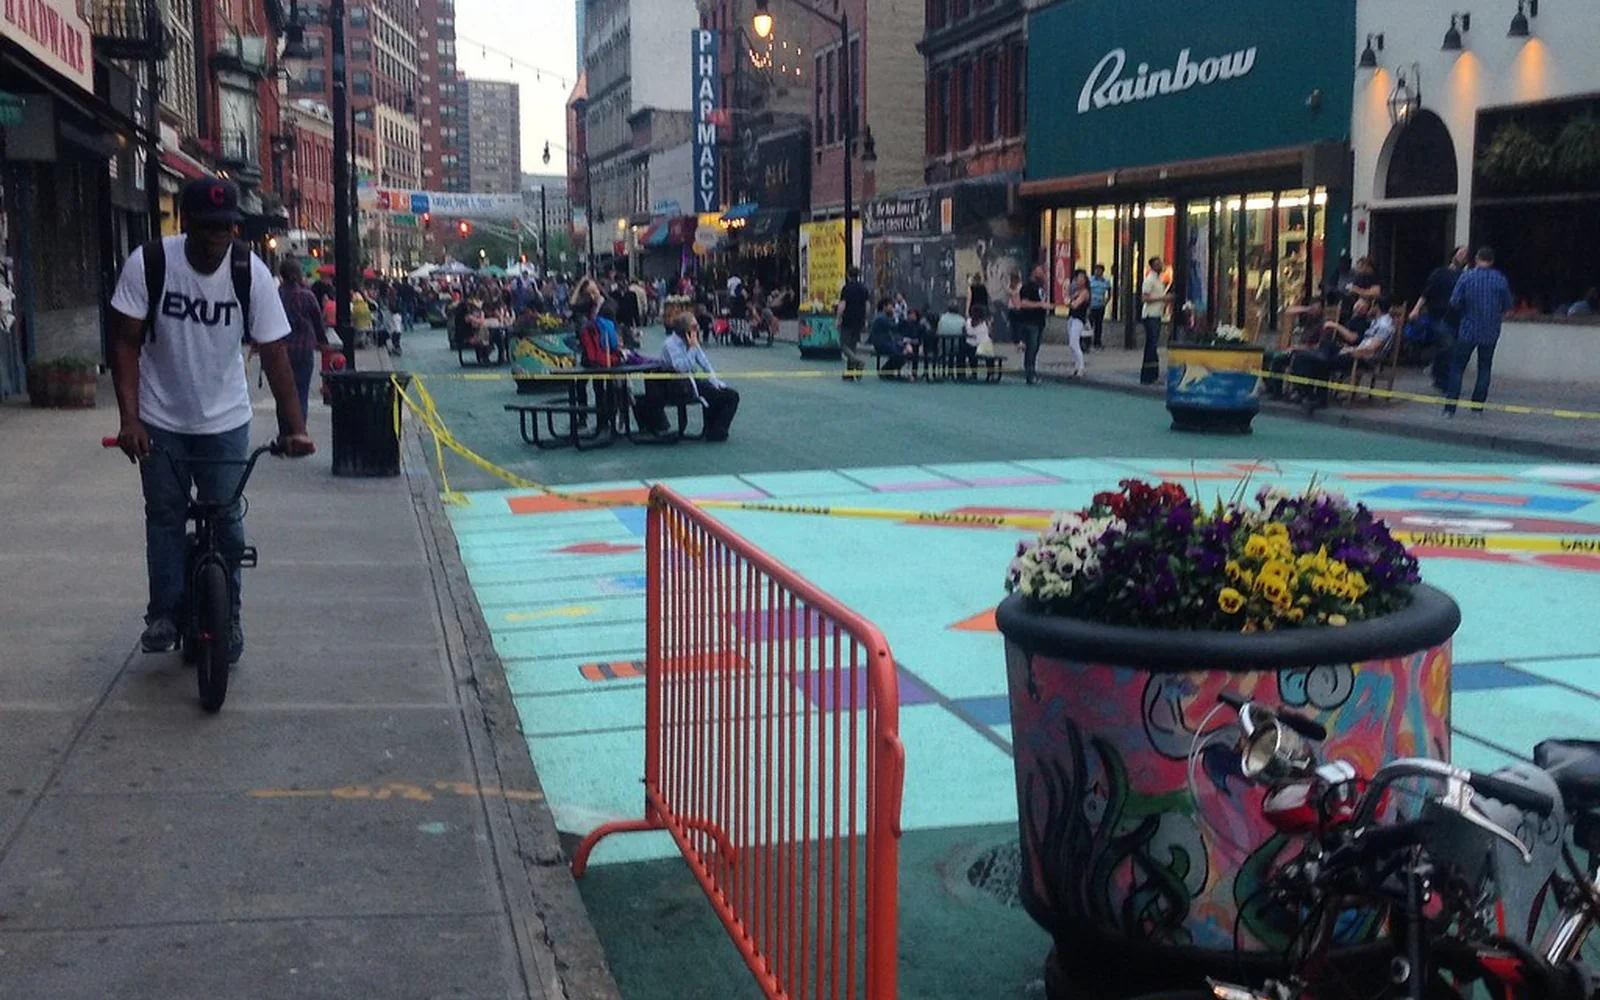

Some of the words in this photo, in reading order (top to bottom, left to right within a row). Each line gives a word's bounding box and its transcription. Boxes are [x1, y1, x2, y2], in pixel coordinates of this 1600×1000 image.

[1077, 47, 1257, 114] Rainbow
[698, 30, 717, 213] PHARMACY
[209, 186, 224, 207] C
[162, 291, 238, 326] EXUT
[1410, 531, 1485, 548] CAUTION
